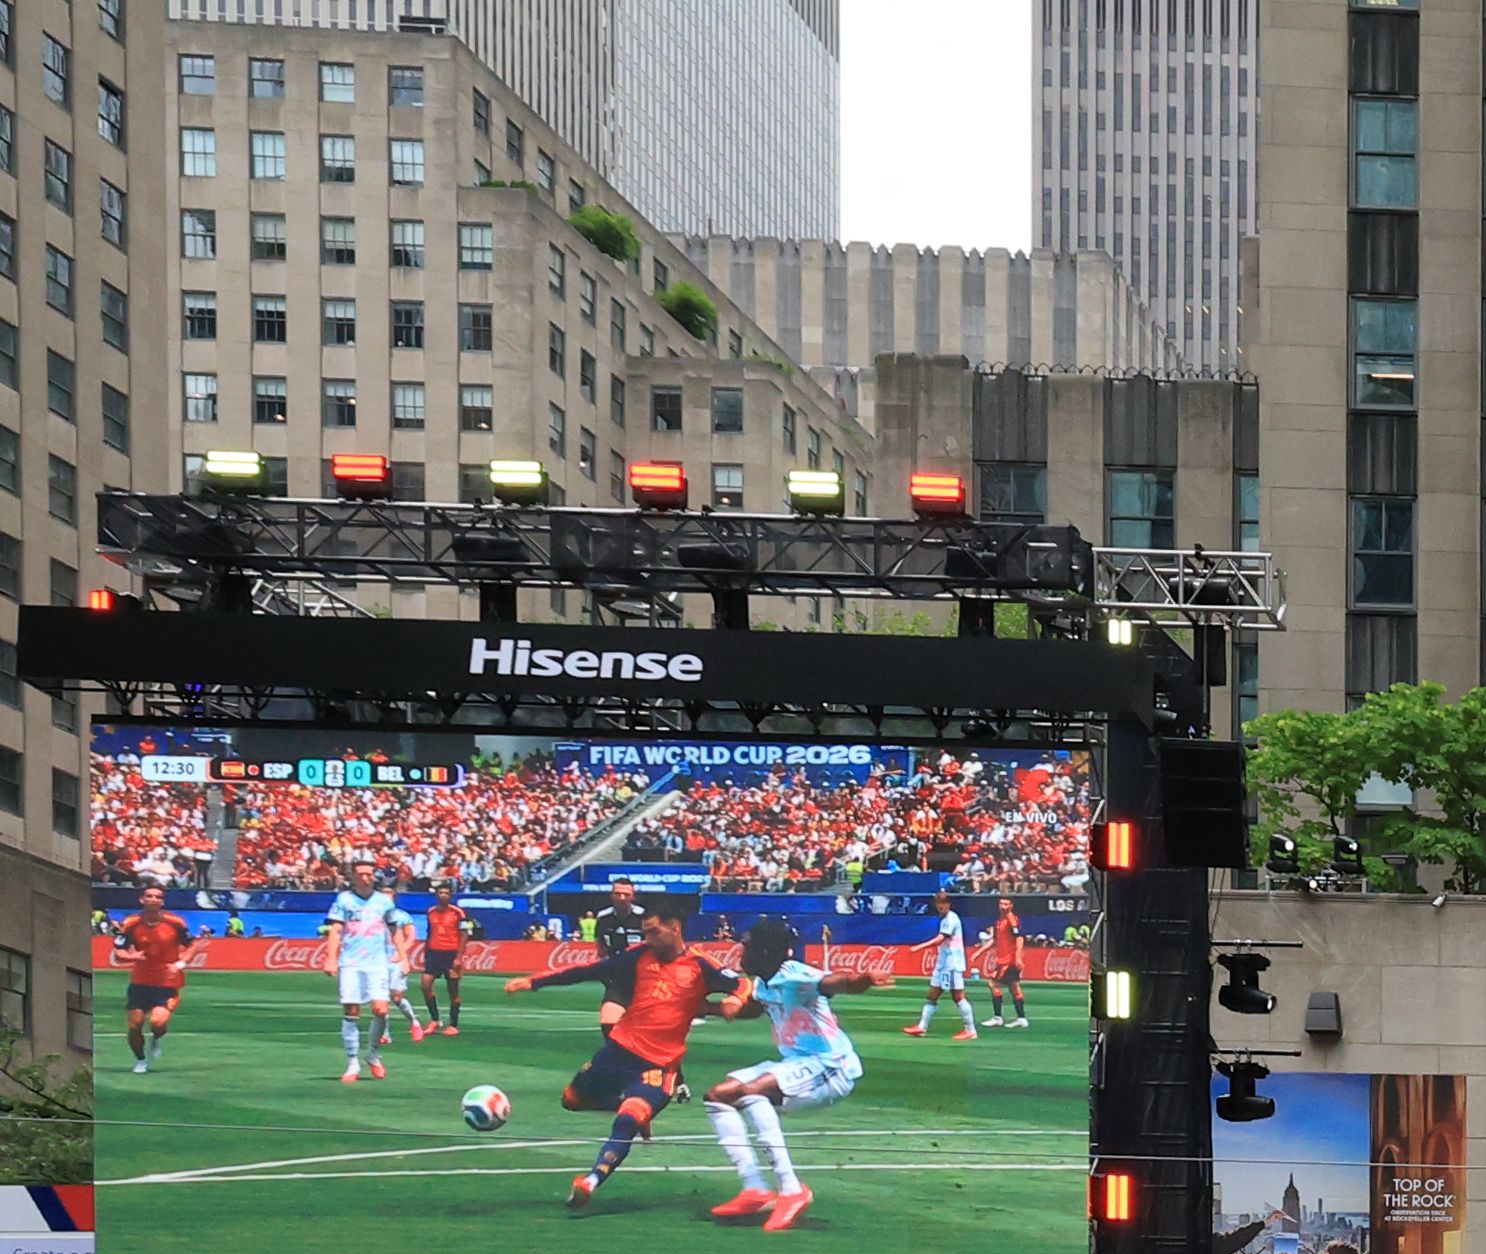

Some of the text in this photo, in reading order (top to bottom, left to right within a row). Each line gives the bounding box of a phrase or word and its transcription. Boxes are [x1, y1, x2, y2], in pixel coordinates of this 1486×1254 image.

[469, 638, 703, 682] Hisense
[590, 745, 871, 766] FIFA WORLD CUP 2026
[152, 761, 195, 776] 12:30
[263, 763, 293, 779] ESP
[306, 765, 316, 780] 0
[353, 766, 363, 781] 0
[377, 765, 405, 782] BEL
[1004, 811, 1058, 825] EN VIVO
[1048, 899, 1073, 911] LOS
[1393, 1179, 1445, 1192] TOP OF
[1384, 1194, 1453, 1208] THE ROCK
